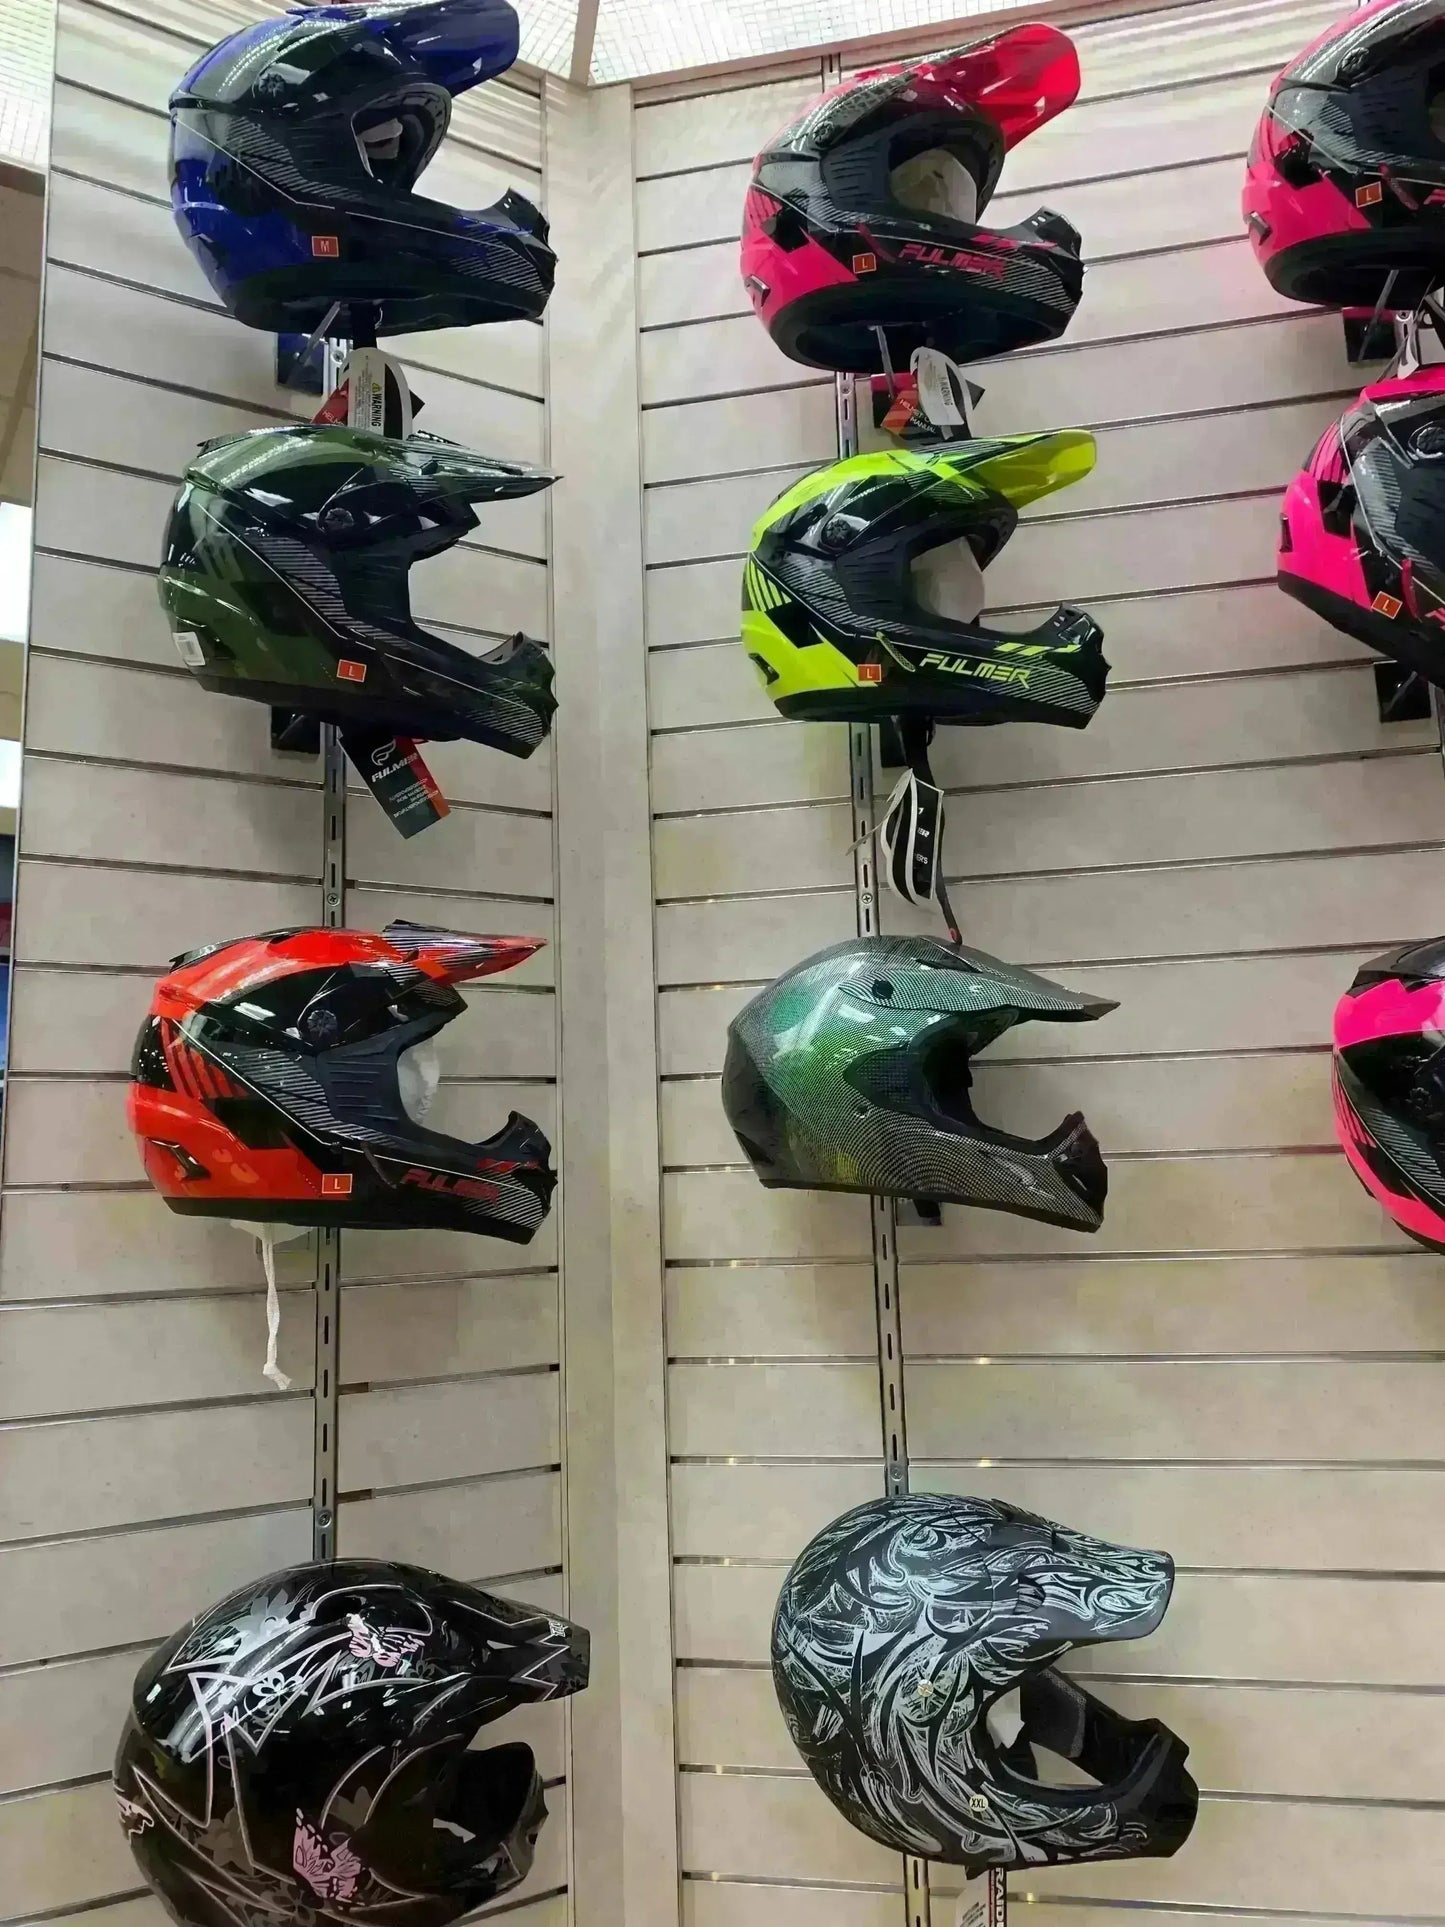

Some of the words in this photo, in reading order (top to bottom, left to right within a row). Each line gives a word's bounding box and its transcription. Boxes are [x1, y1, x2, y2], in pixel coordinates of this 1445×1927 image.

[898, 243, 1005, 281] FULMER
[371, 393, 383, 427] WARNING
[910, 416, 936, 433] MANUAL
[919, 652, 1032, 689] FULMER
[372, 752, 418, 782] FULMER
[971, 1799, 986, 1809] XXL
